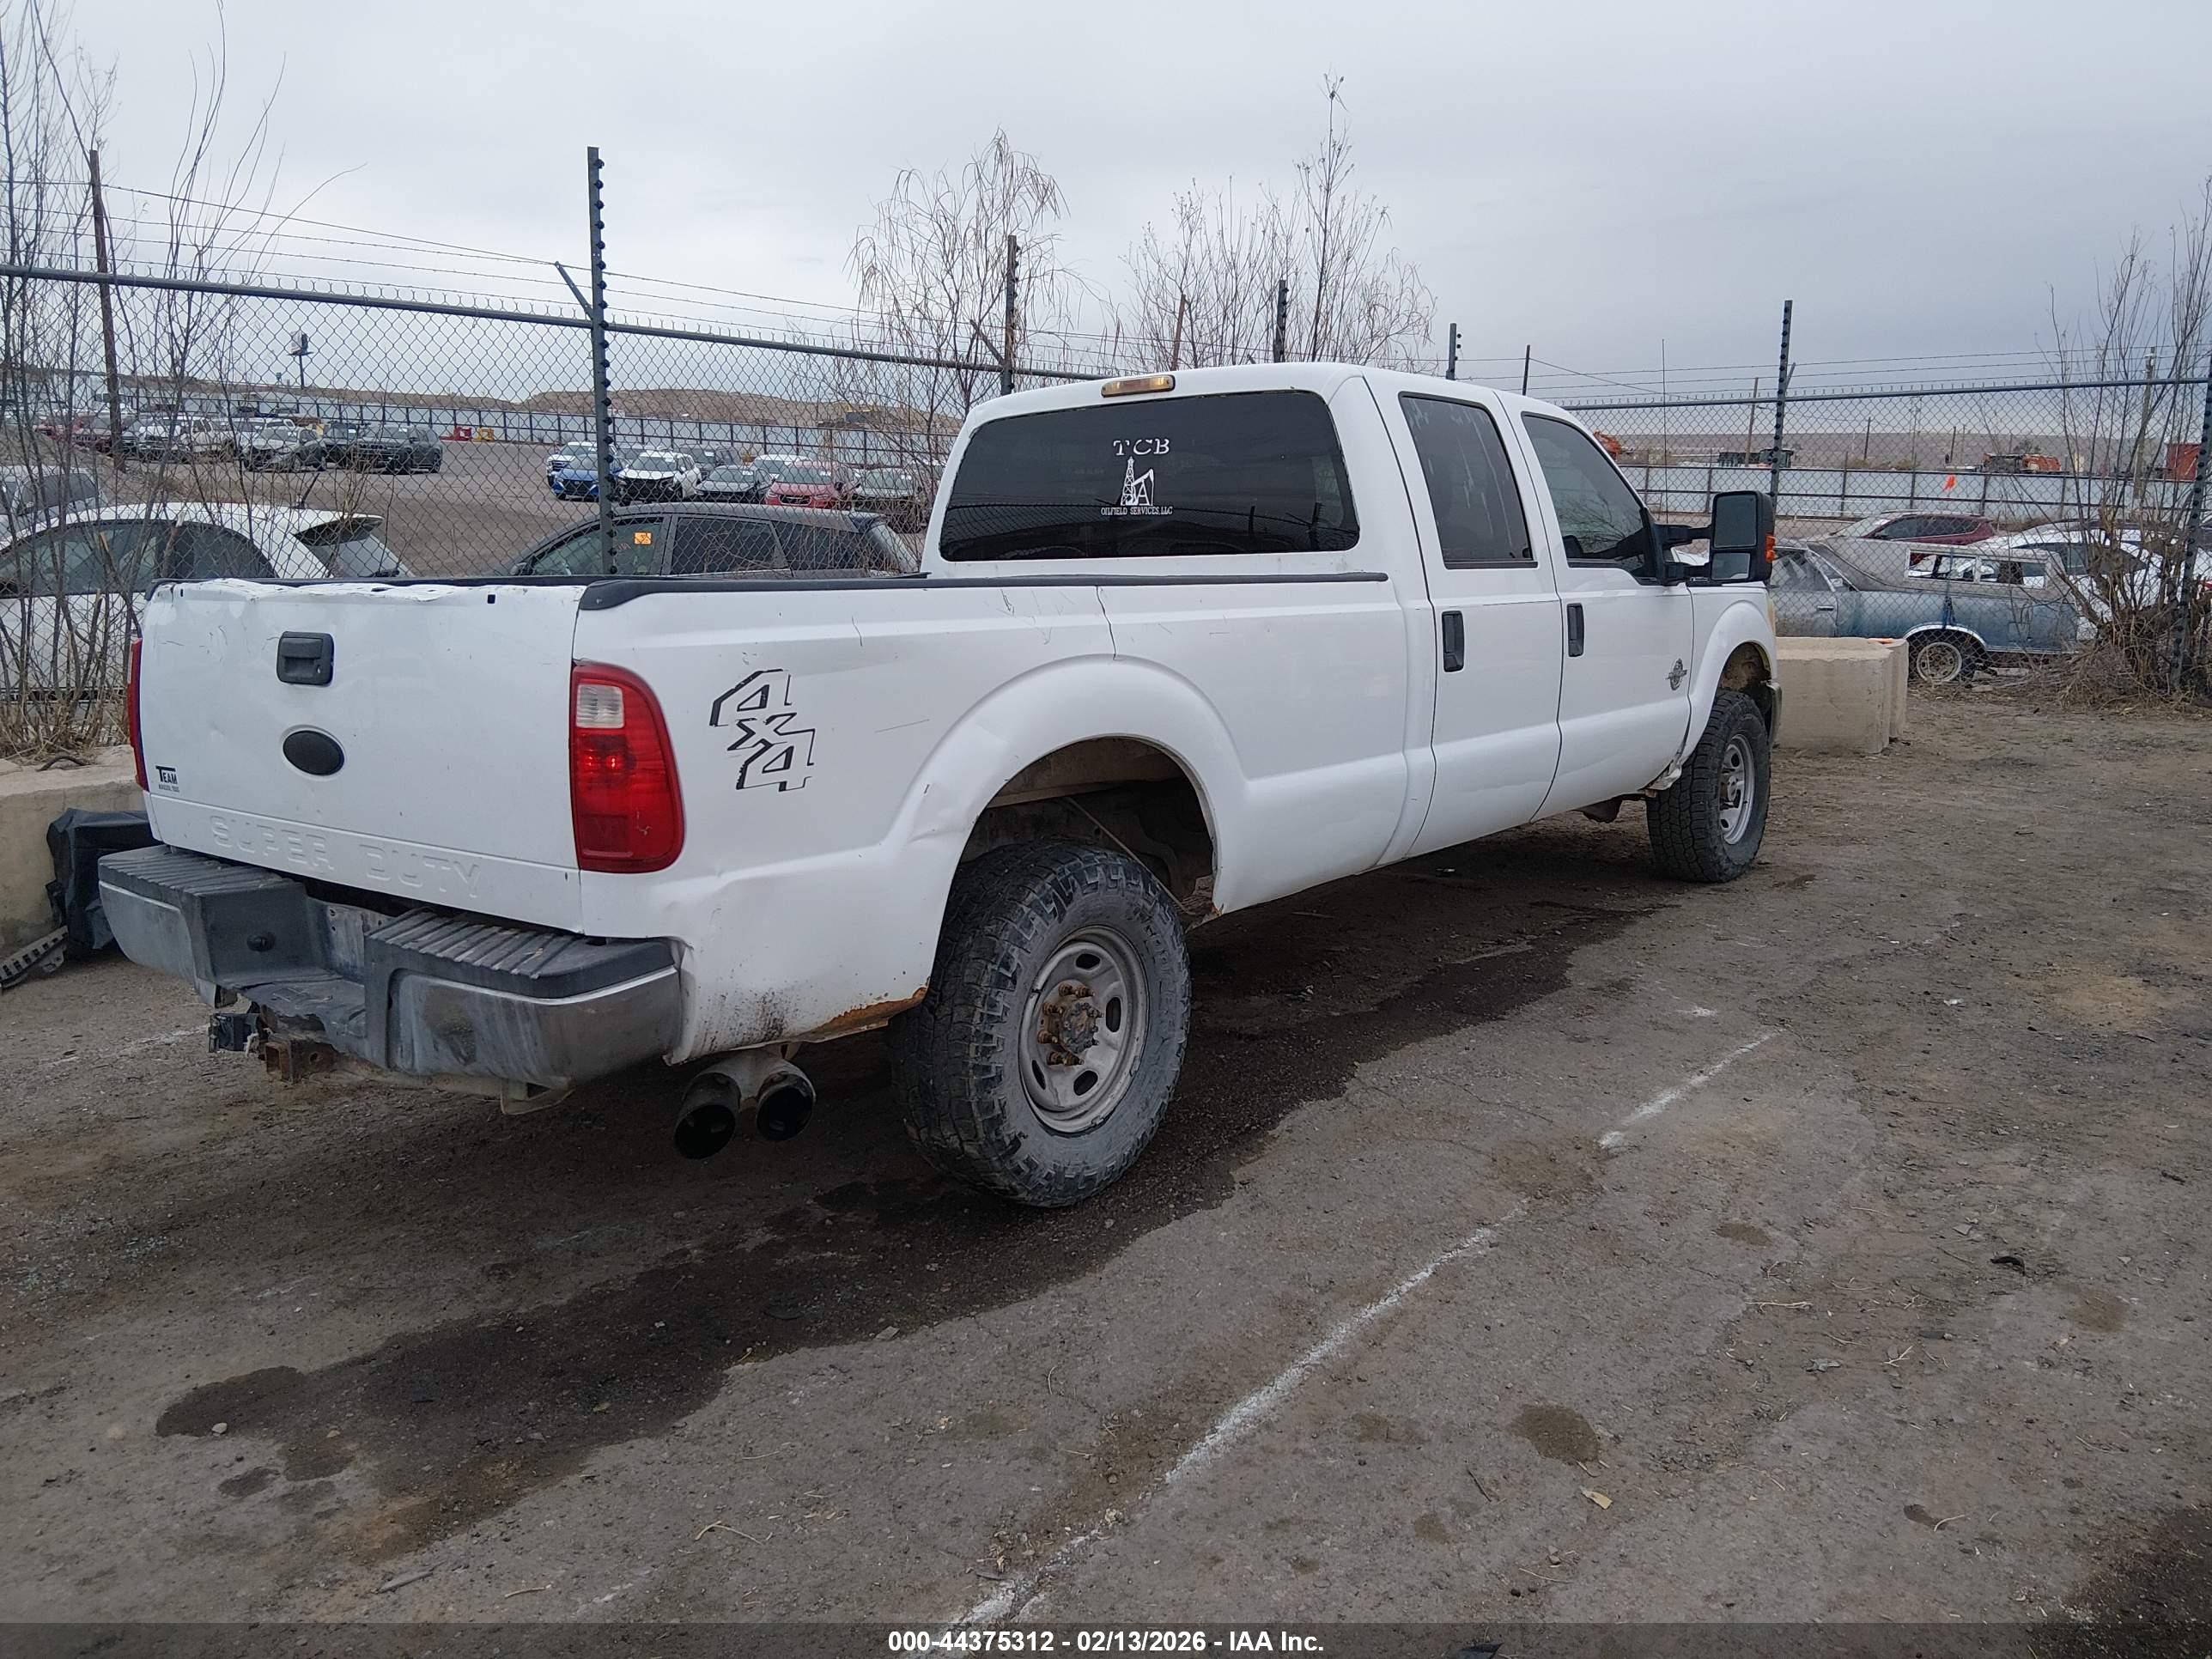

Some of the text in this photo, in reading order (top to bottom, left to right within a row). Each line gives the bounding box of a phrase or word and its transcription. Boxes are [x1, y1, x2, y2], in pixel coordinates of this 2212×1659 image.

[1113, 438, 1170, 456] TCB
[1100, 507, 1128, 516] OILFIELD
[209, 814, 483, 899] SUPER DUTY
